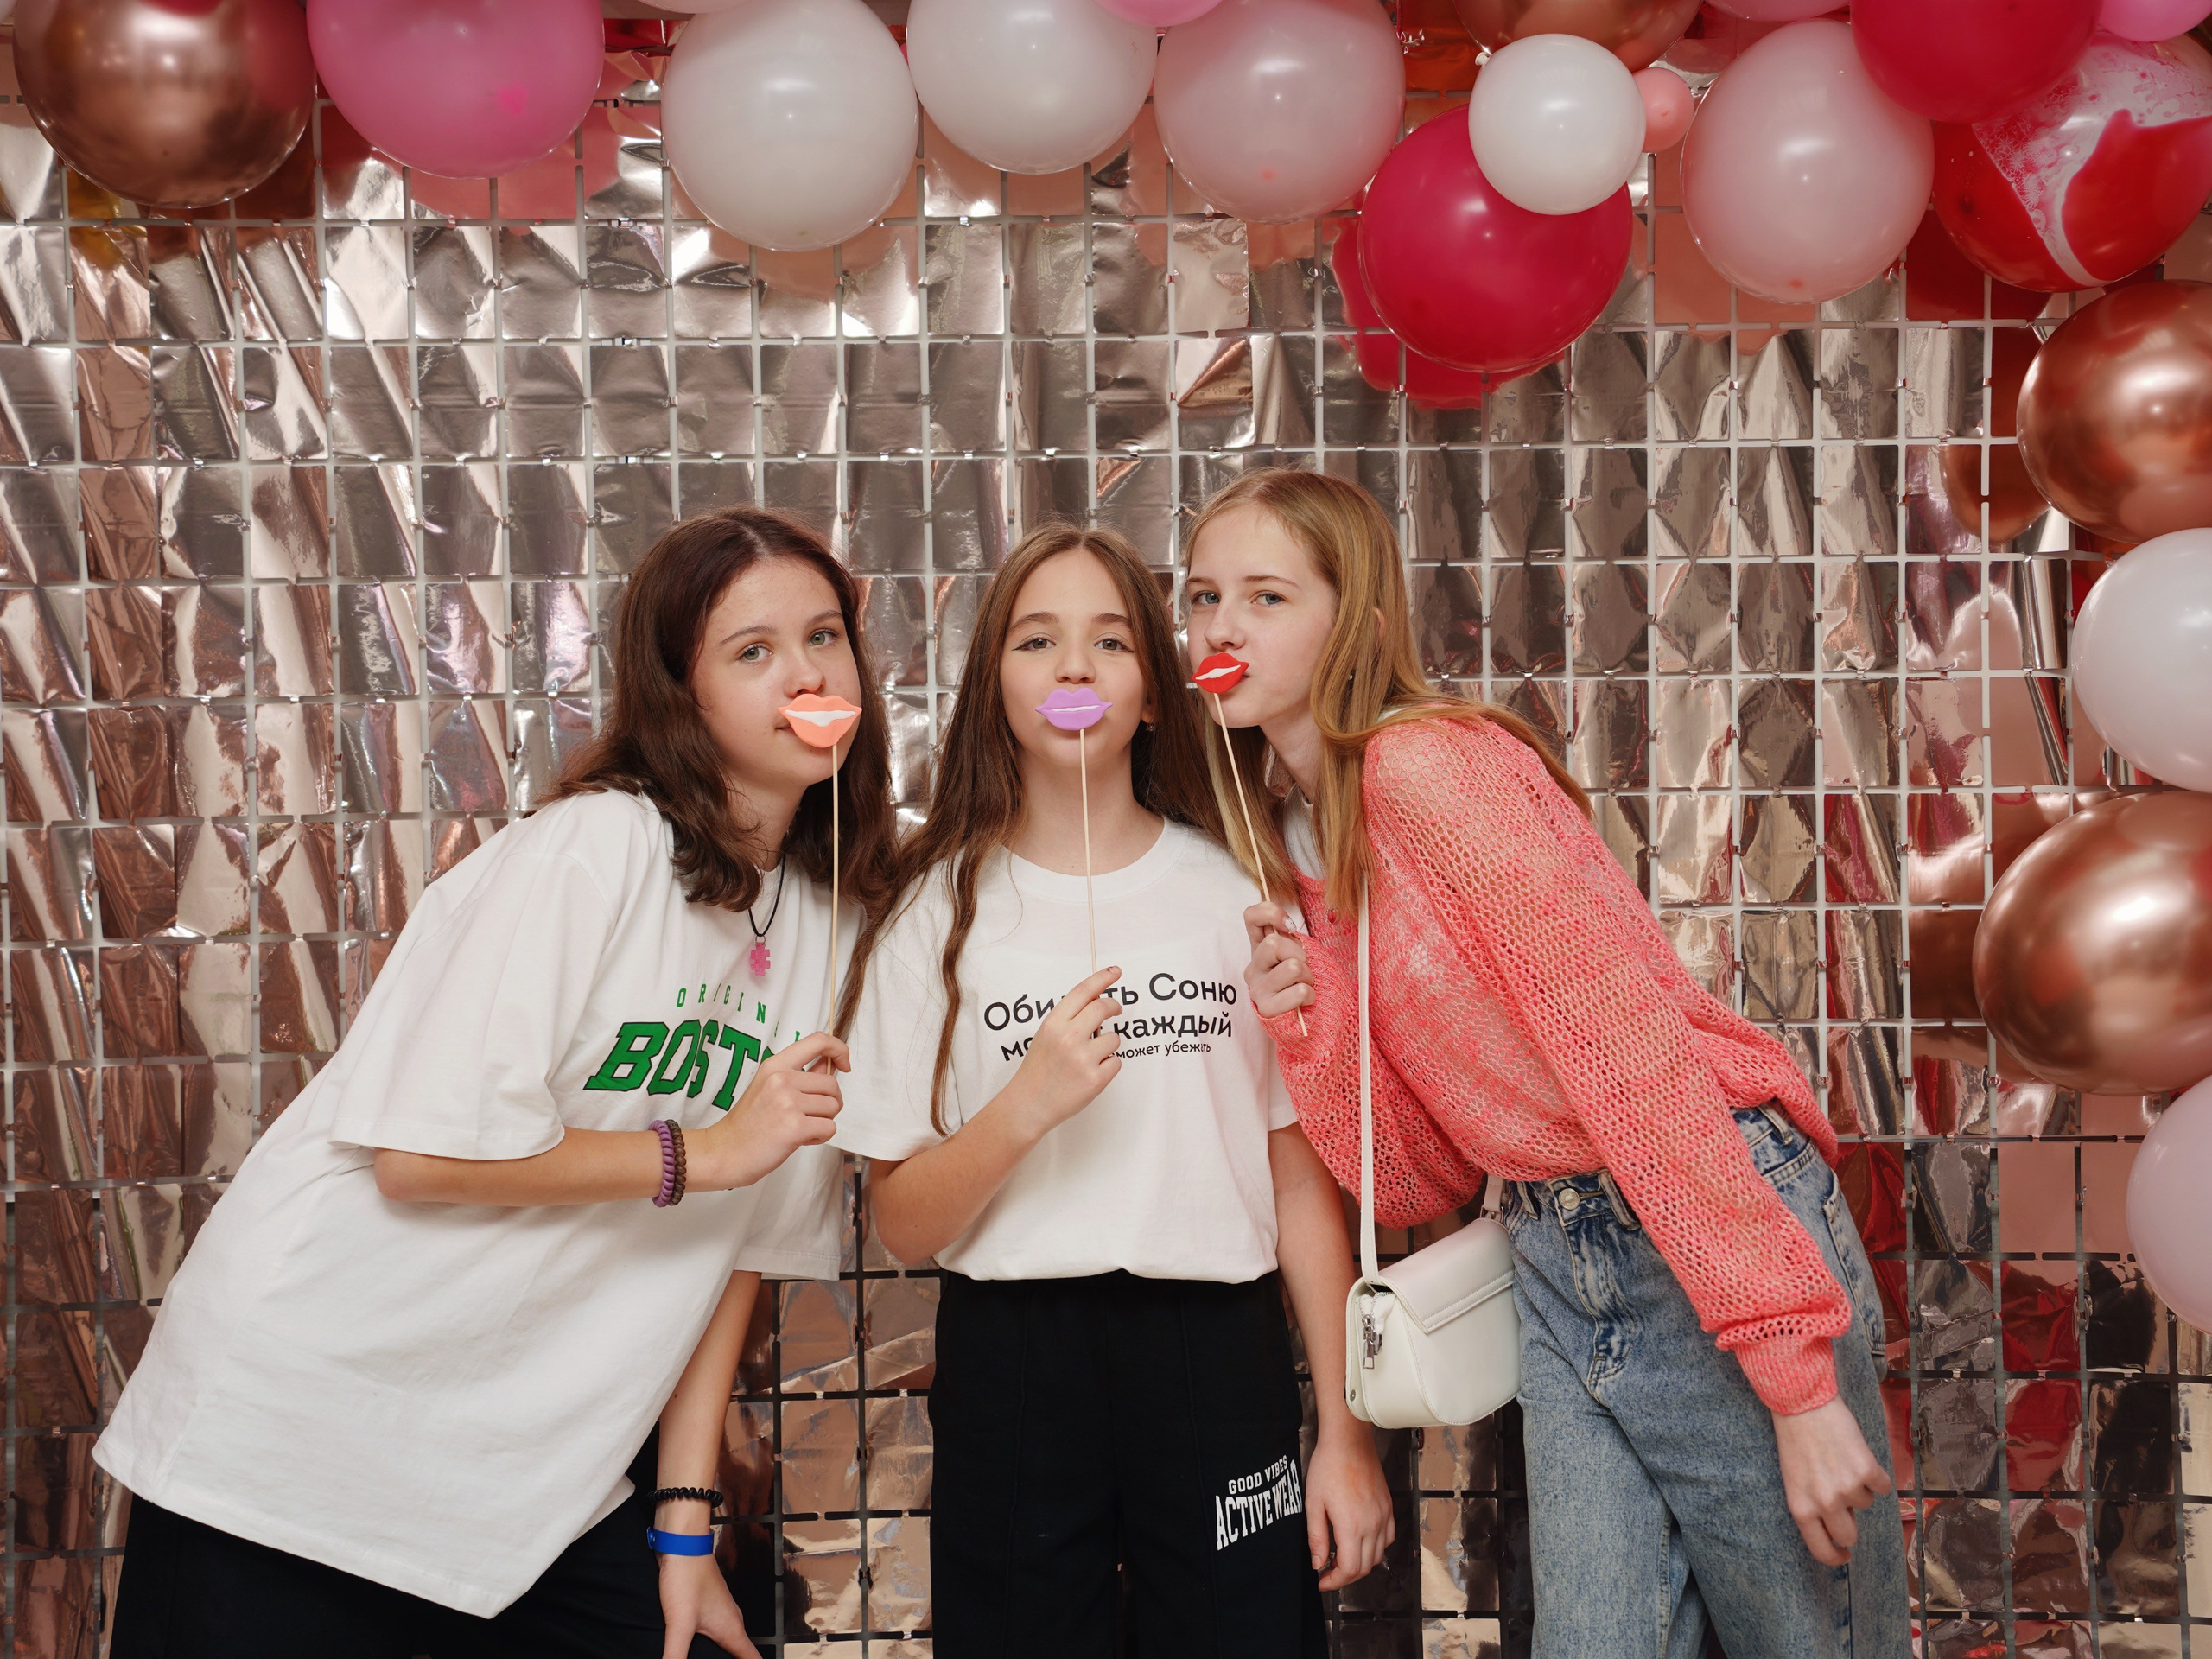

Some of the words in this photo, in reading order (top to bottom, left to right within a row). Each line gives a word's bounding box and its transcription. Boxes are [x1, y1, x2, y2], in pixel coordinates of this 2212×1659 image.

[677, 983, 800, 1042] ORIGIN
[984, 986, 1139, 1031] Обить
[1148, 972, 1237, 1005] Соню
[1113, 1011, 1232, 1039] каждый
[582, 1019, 775, 1111] BOST
[1112, 1045, 1160, 1059] может
[1228, 1471, 1262, 1495] GOOD
[1264, 1454, 1287, 1483] VIBES
